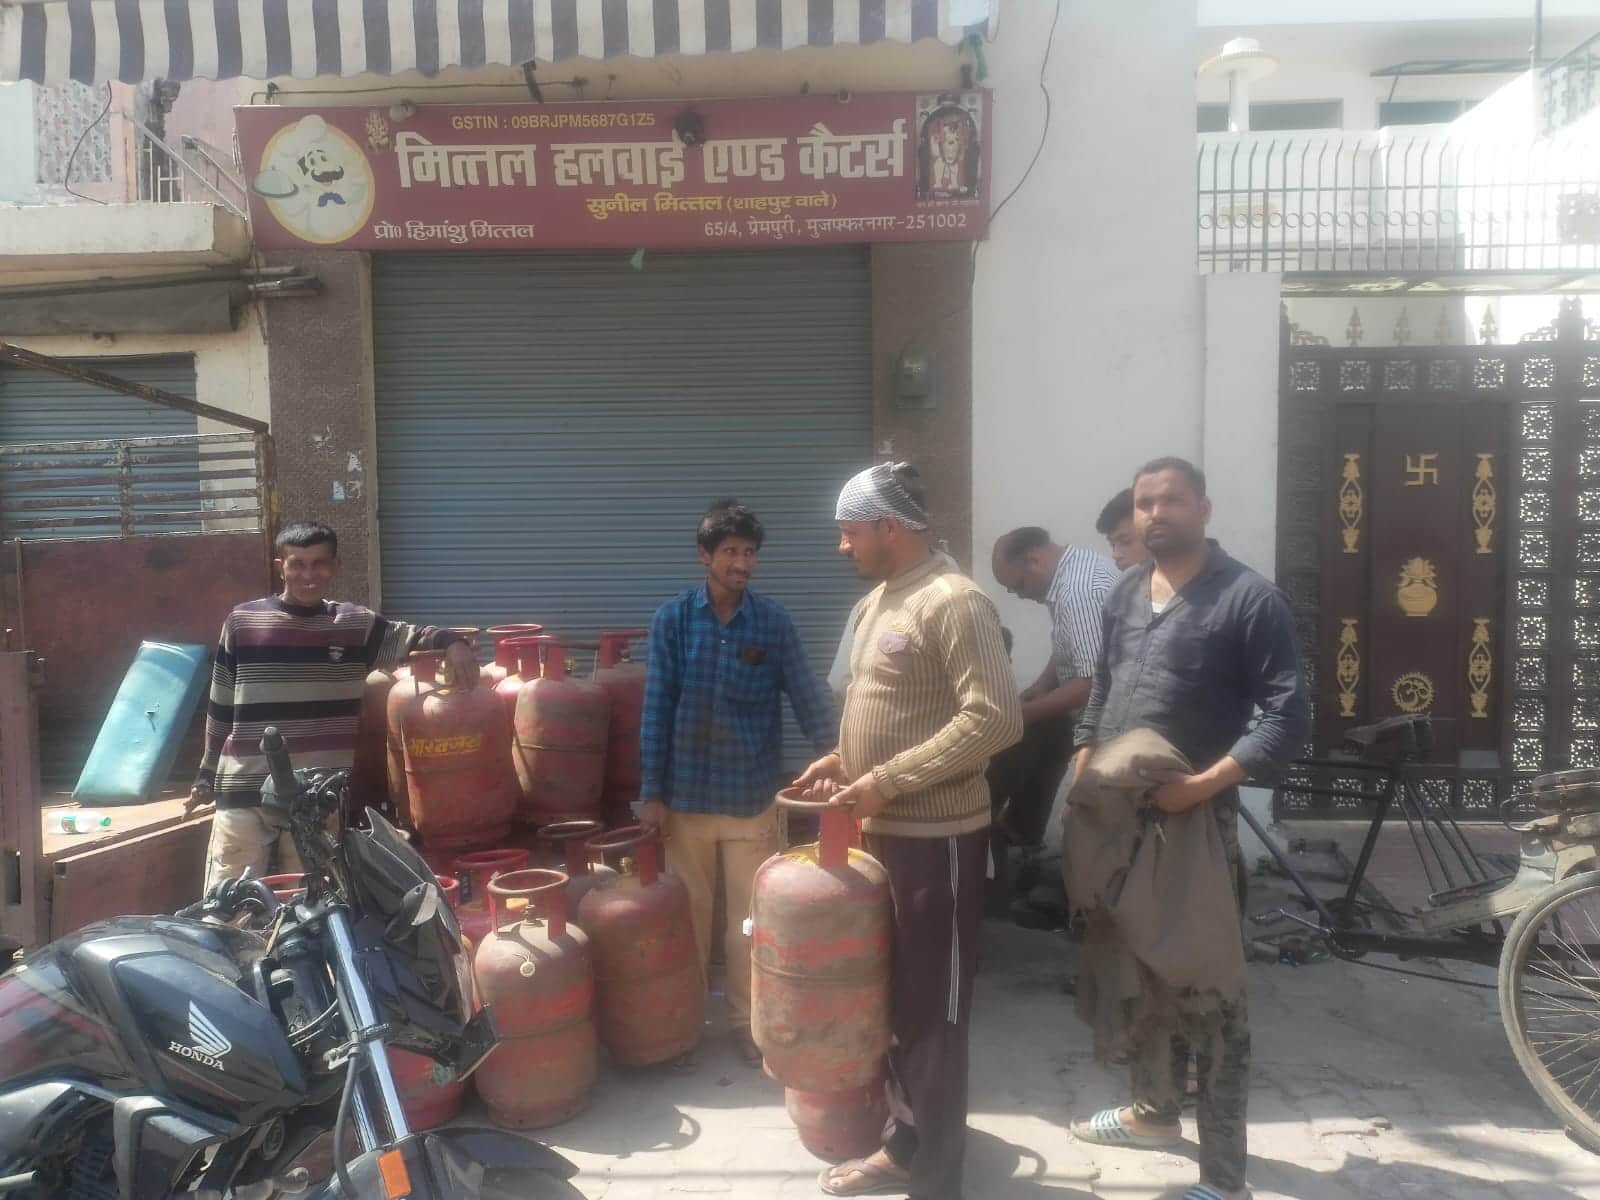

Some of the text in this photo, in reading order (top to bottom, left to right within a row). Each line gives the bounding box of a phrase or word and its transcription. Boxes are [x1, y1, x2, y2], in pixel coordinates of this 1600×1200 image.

[451, 115, 498, 129] GSTIN
[511, 112, 656, 129] 09BRJPM5687G1Z5
[394, 131, 537, 188] मित्तल
[550, 128, 687, 189] हलवाई
[703, 137, 788, 184] एण्ड
[586, 190, 838, 220] सुनील मित्तल (शाहपुर वाले)
[405, 220, 468, 243] हिमांशु
[470, 219, 535, 240] मित्तल
[704, 221, 742, 238] 65/4,
[168, 1041, 225, 1071] HONDA
